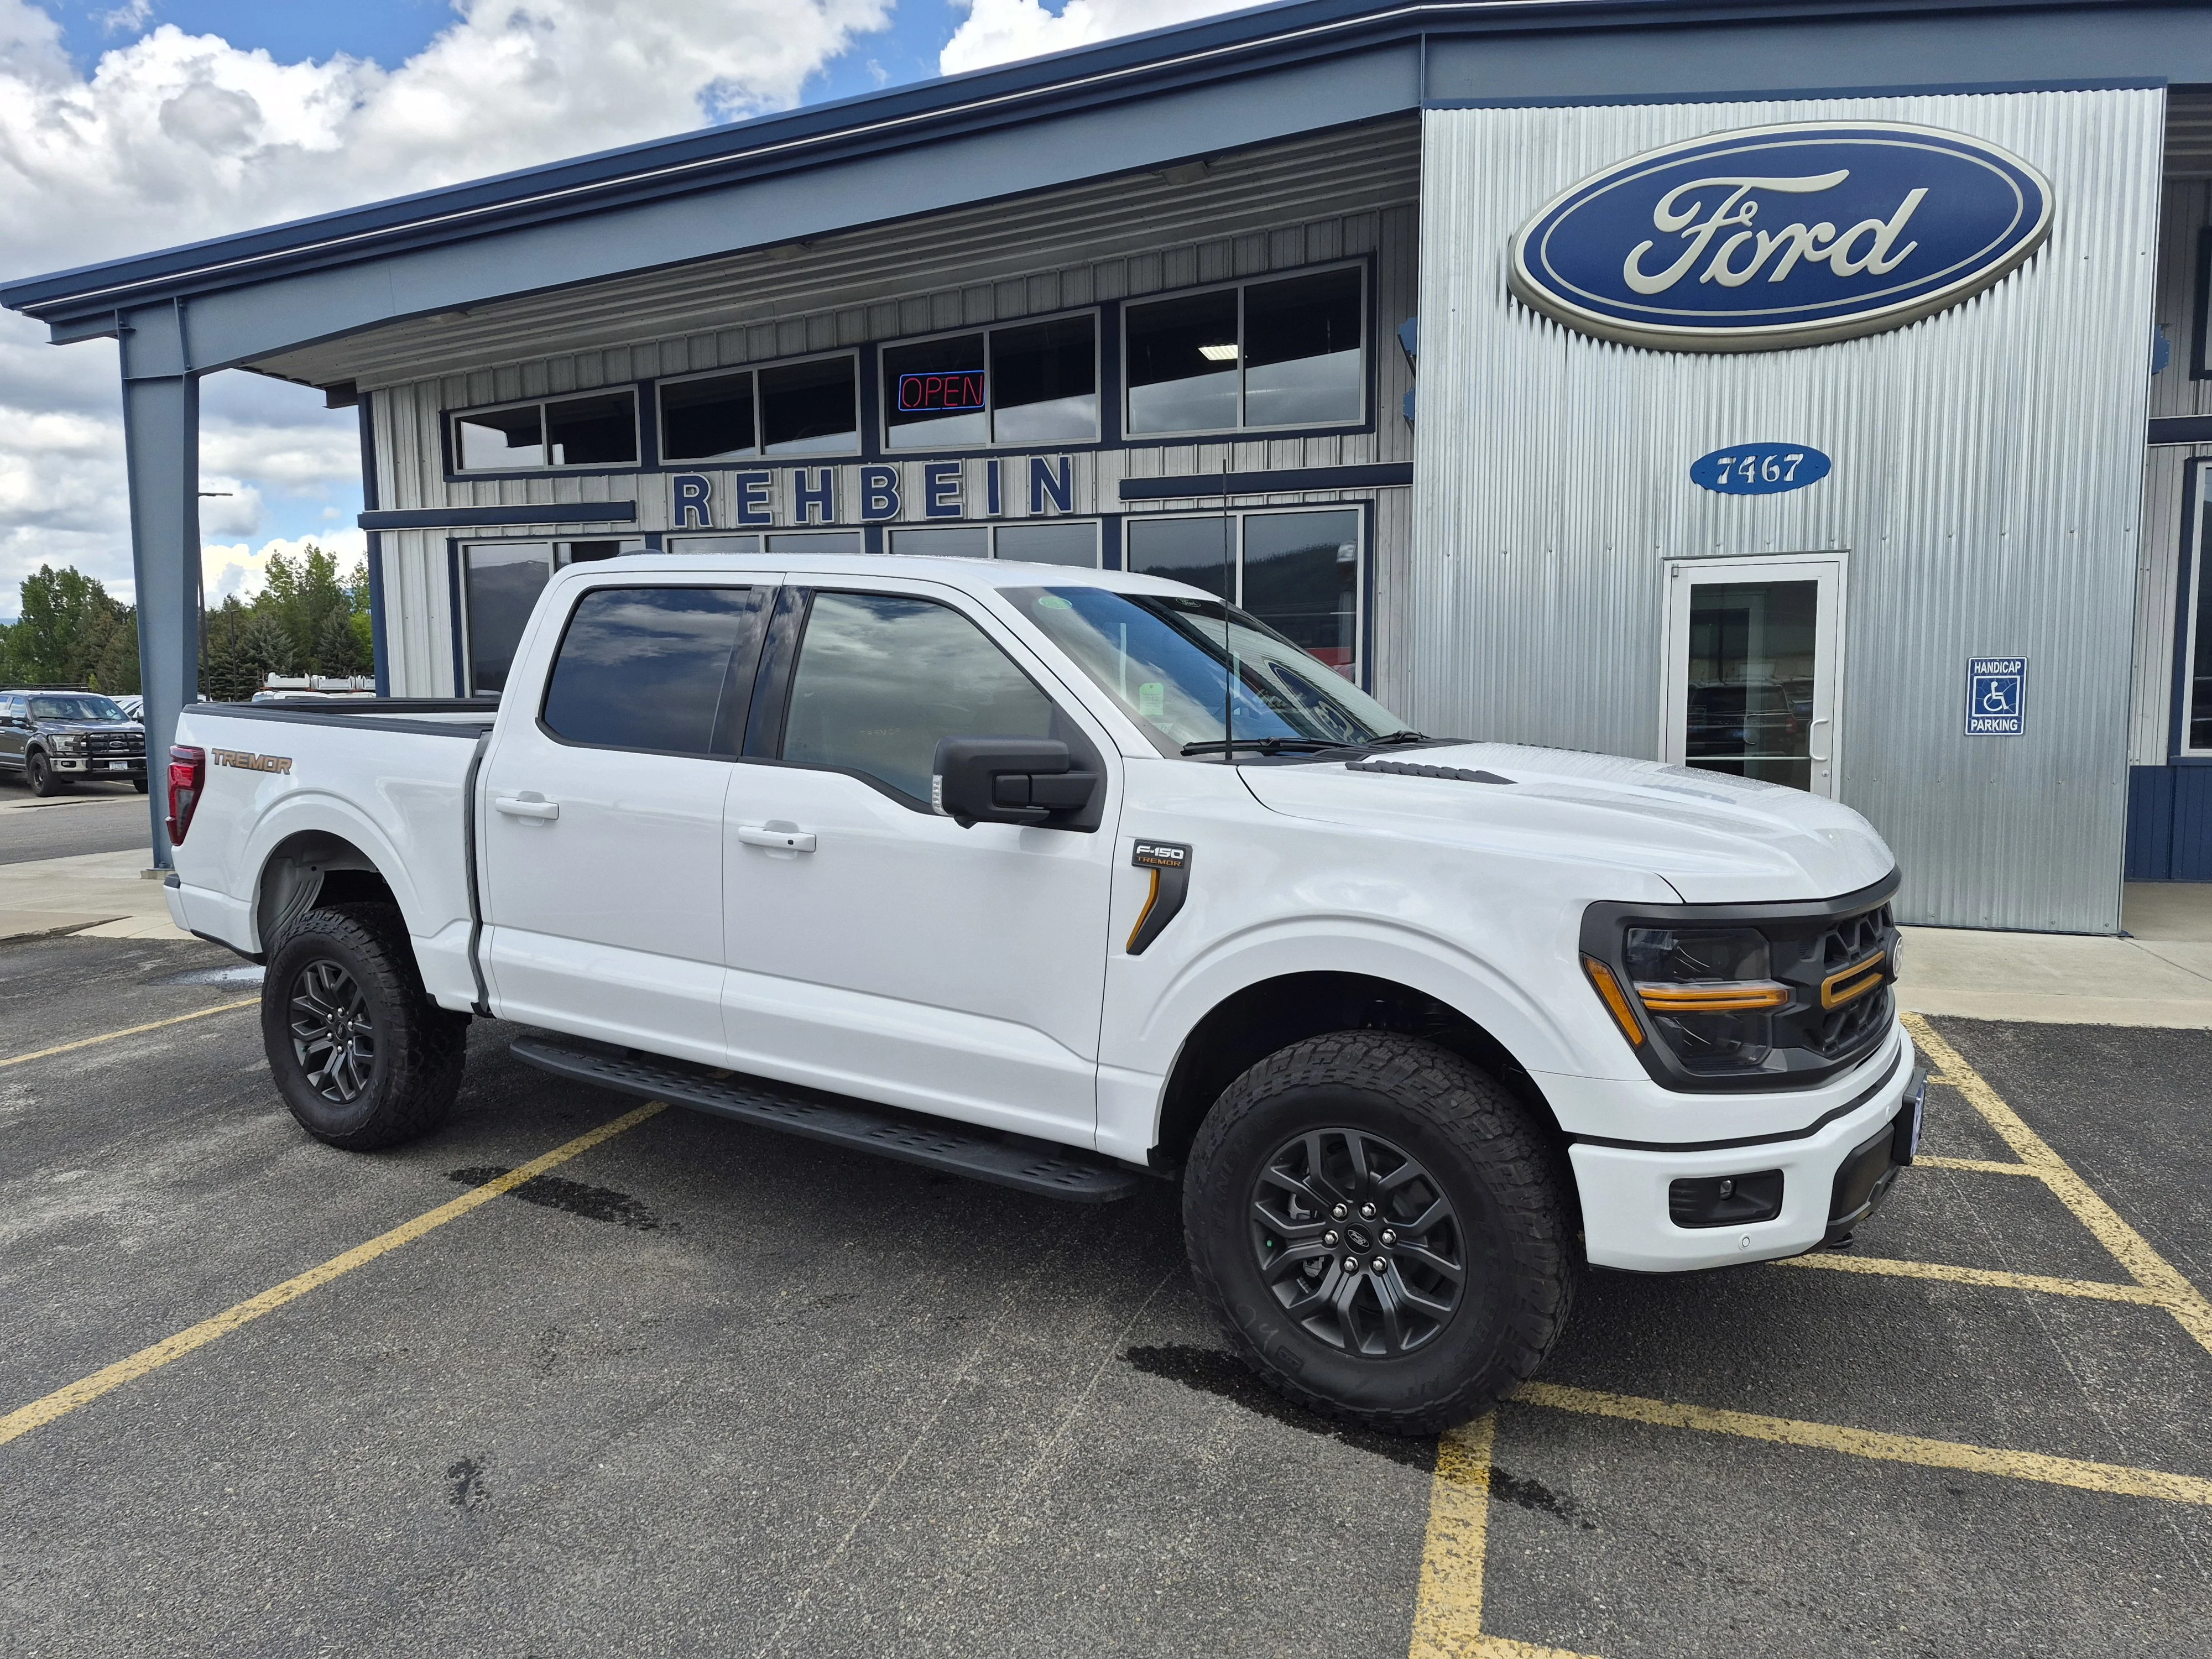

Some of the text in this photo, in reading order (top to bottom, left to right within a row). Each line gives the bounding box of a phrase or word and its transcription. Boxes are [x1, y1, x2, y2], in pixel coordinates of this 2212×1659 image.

[1624, 169, 1928, 294] Ford
[902, 375, 983, 407] OPEN
[1717, 453, 1804, 484] 7467
[672, 453, 1074, 528] REHBEIN
[1974, 661, 2021, 674] HANDICAP
[1971, 719, 2018, 731] PARKING
[211, 748, 293, 775] TREMOR
[1136, 845, 1184, 859] F-150
[1137, 857, 1181, 867] TREMOR
